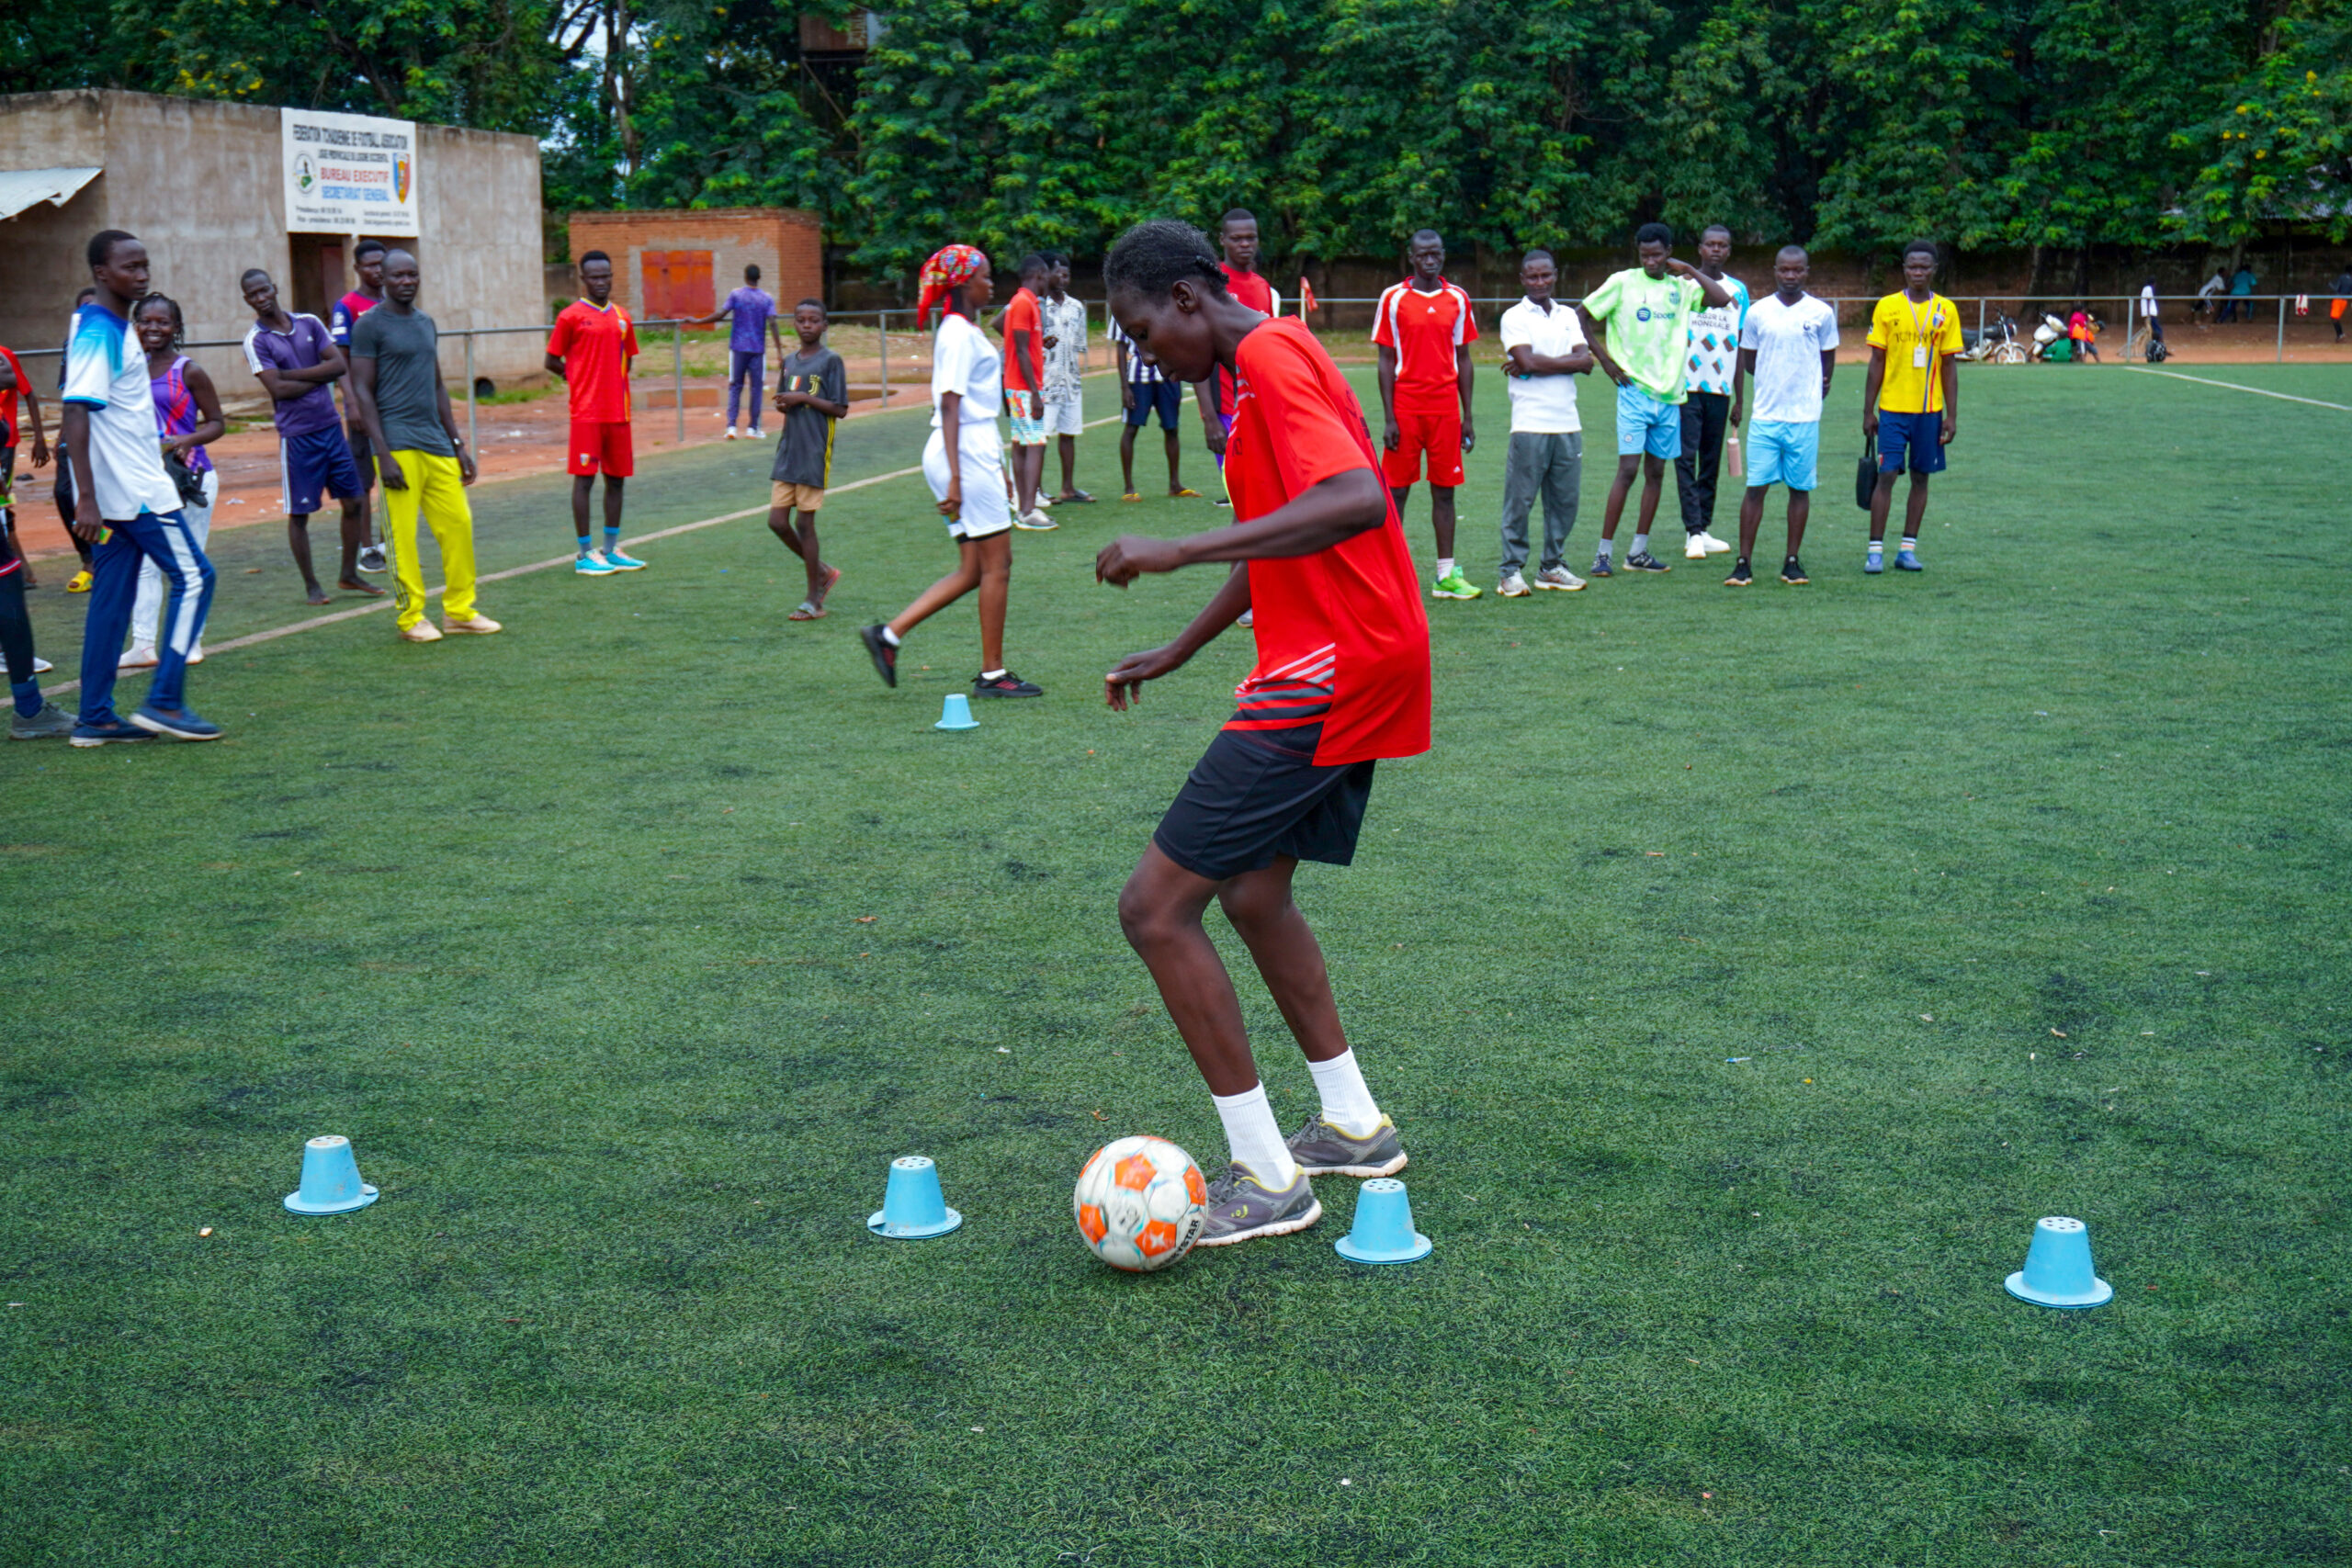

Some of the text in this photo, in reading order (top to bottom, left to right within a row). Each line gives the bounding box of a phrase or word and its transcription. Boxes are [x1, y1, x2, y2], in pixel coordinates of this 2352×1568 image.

[321, 167, 390, 183] BUREAU EXECUTIF
[322, 186, 390, 202] SECRETARIAT GENERAL
[1654, 310, 1675, 320] Spot
